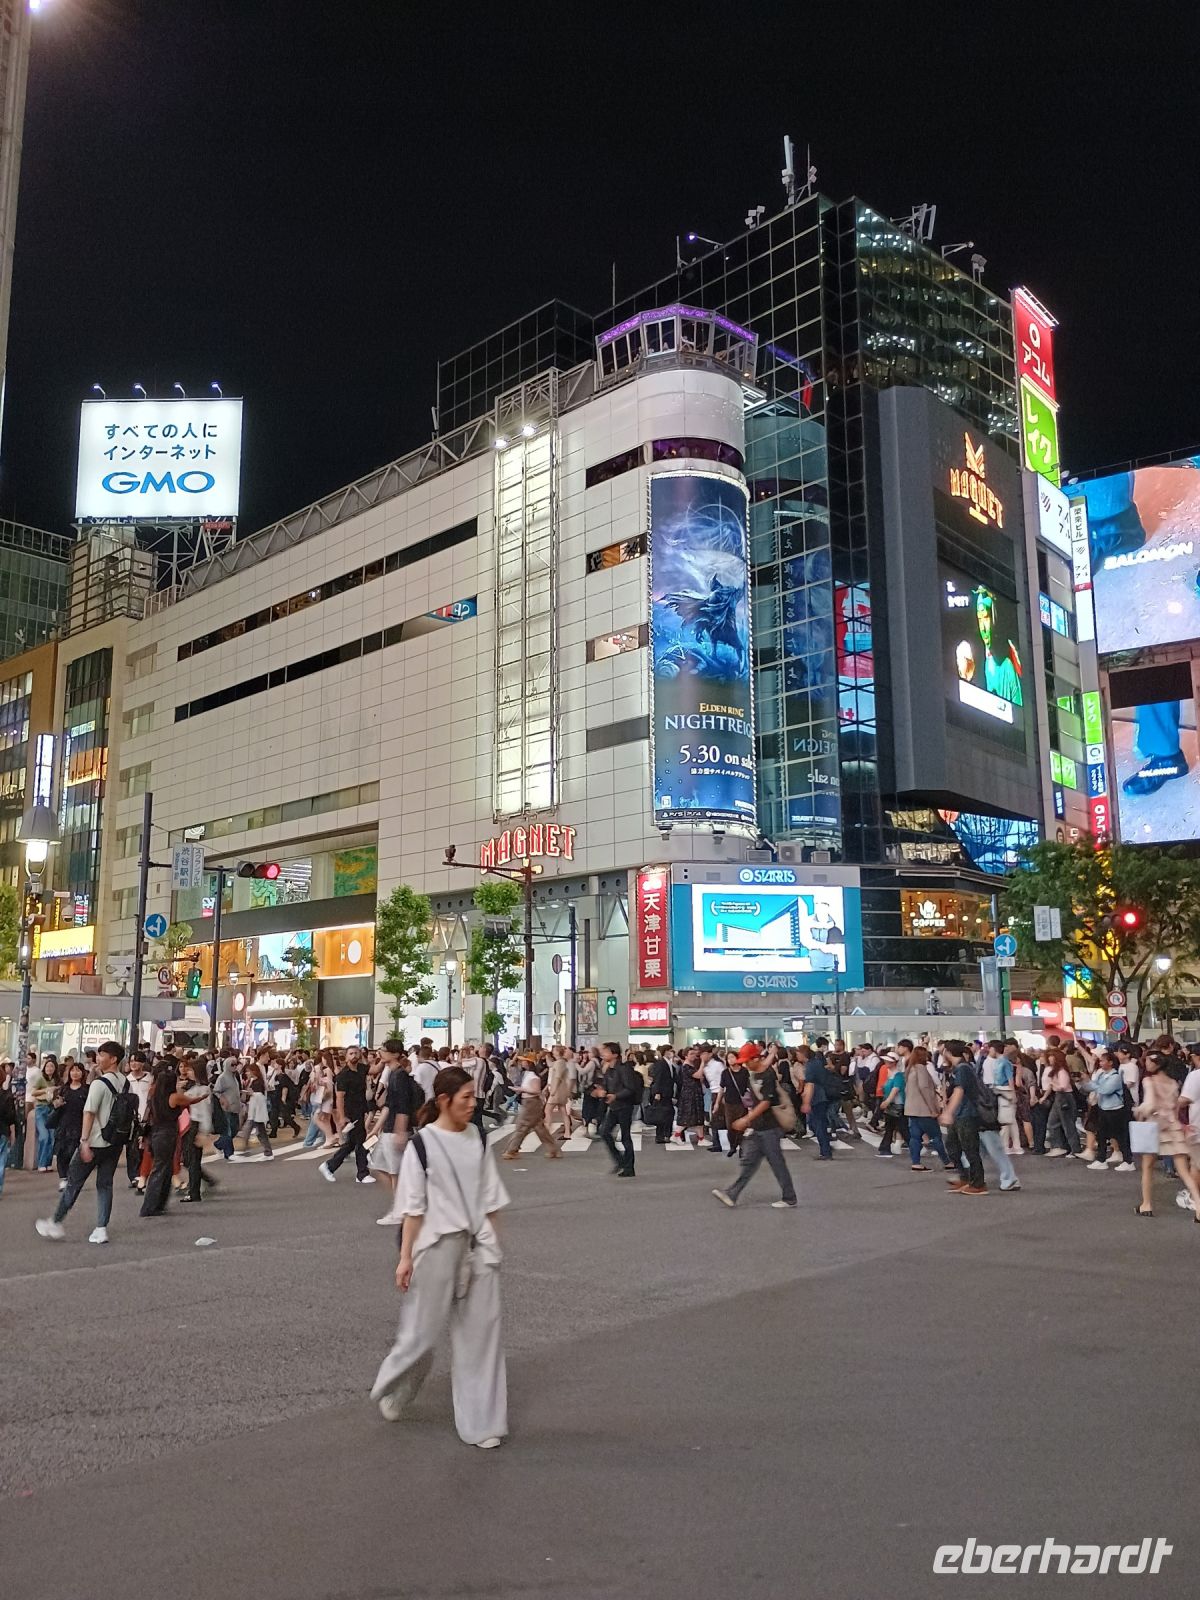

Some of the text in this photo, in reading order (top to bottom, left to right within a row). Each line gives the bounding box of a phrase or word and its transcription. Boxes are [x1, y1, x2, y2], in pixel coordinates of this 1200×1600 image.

[1022, 340, 1051, 387] アコム
[104, 422, 218, 440] すべての人に
[1026, 393, 1052, 464] レイク
[103, 444, 217, 461] インターネット
[101, 470, 216, 495] GMO
[950, 467, 1003, 528] MAGNET
[1103, 541, 1194, 570] SALOMON
[699, 702, 745, 718] ELDEN RING
[680, 744, 720, 764] 5.30
[724, 753, 740, 766] on
[480, 823, 577, 875] MAGNET
[179, 846, 191, 887] 渋谷駅前
[643, 893, 662, 979] 天津甘栗
[912, 919, 946, 927] COFFEE
